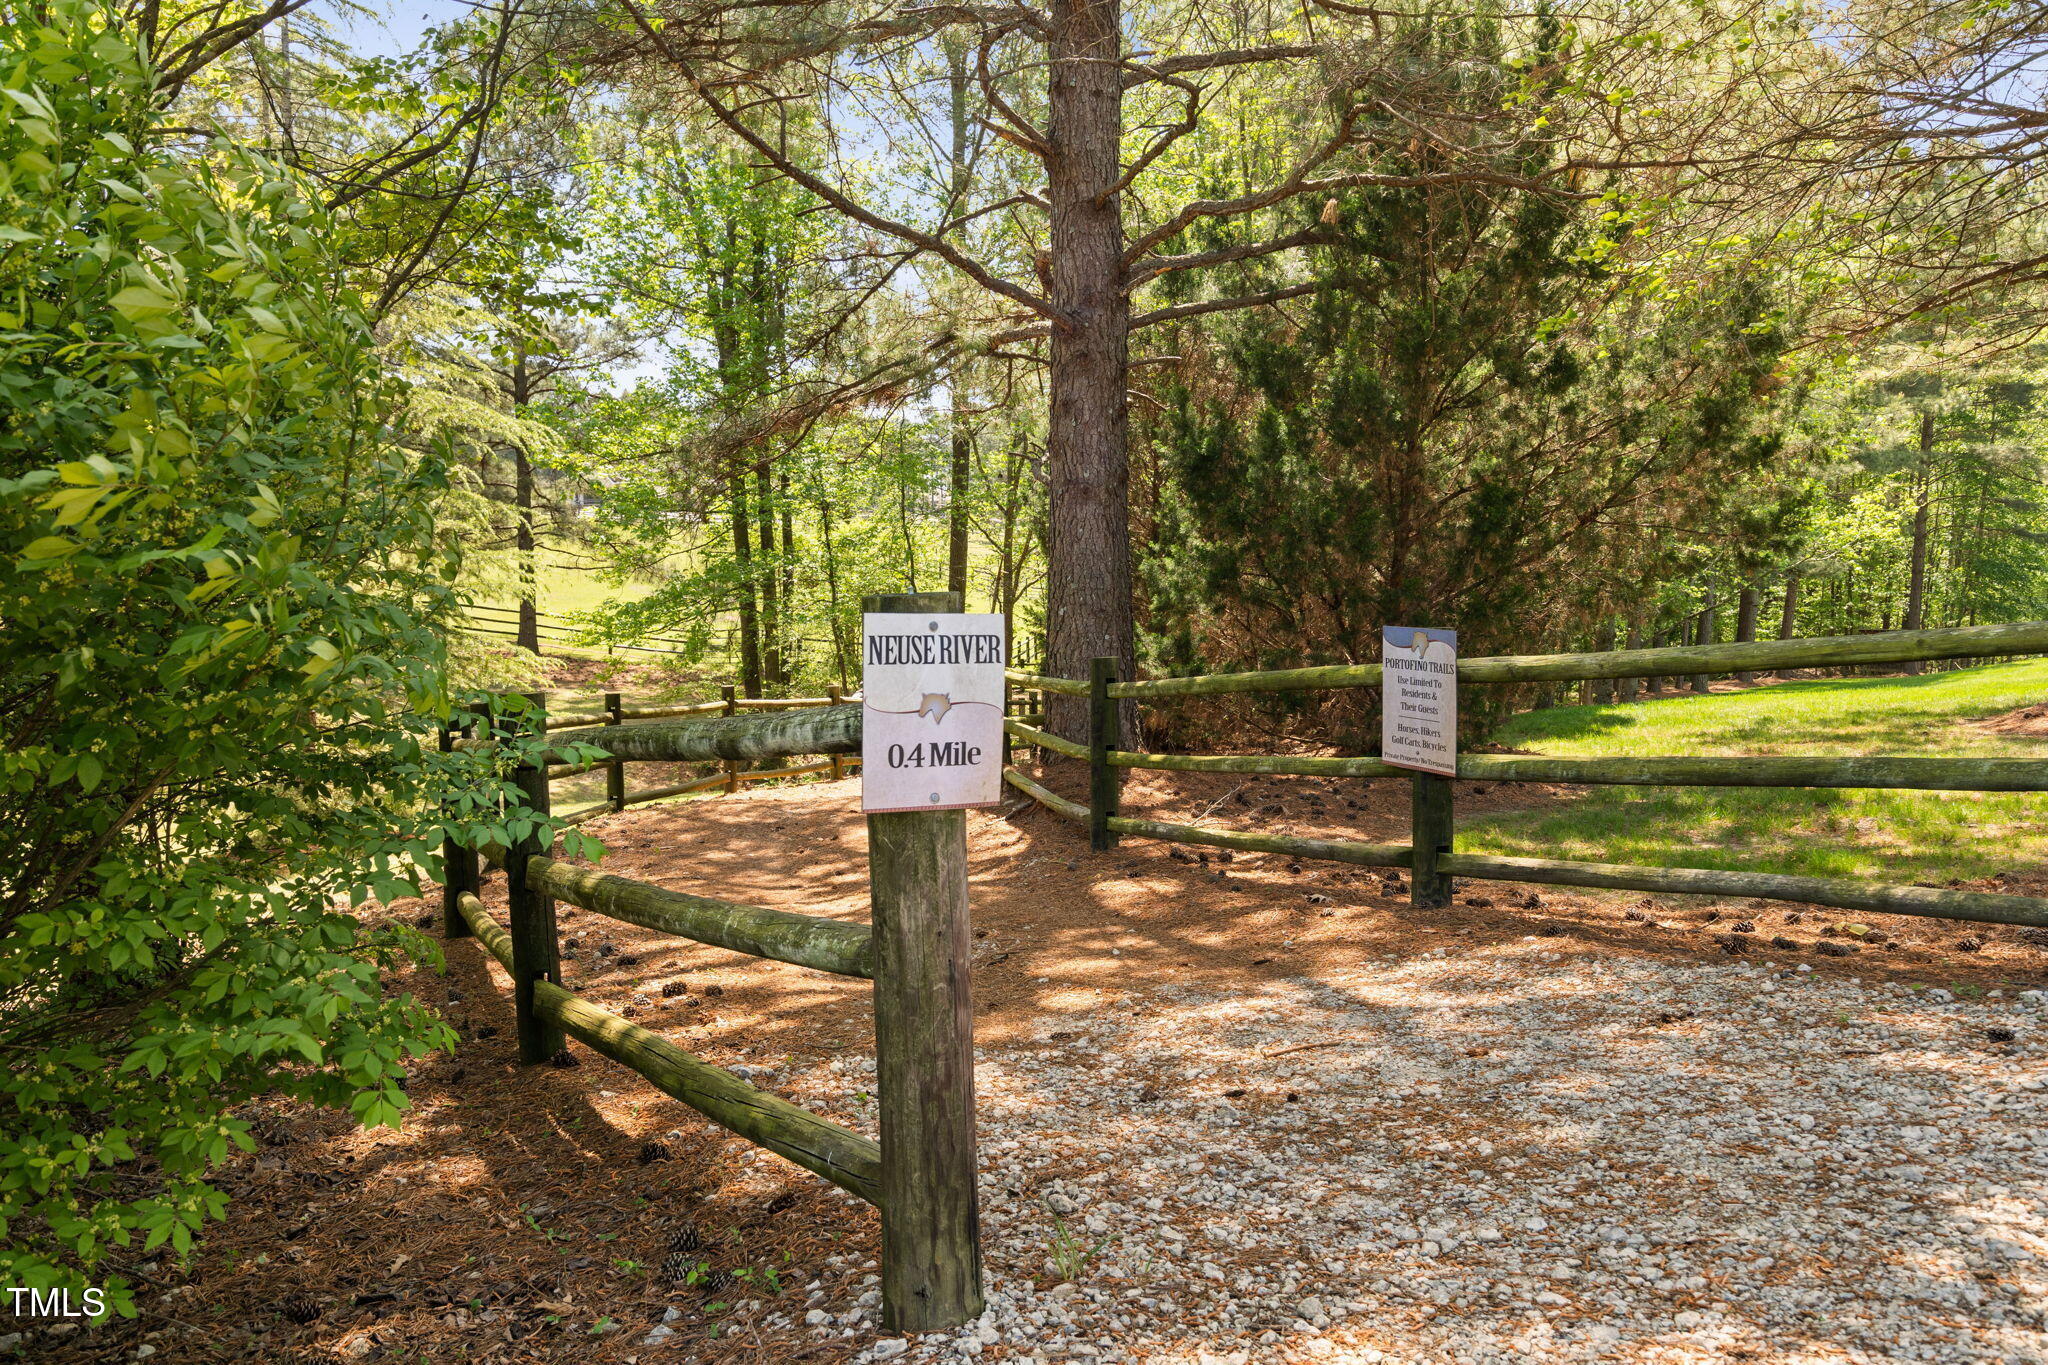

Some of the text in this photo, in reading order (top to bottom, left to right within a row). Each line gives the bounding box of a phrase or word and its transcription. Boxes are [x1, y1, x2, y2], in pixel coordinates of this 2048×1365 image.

[868, 635, 1002, 665] NEUSE RIVER
[1385, 658, 1454, 674] PORTOFINO TRAILS
[1398, 676, 1442, 688] Use Limited To
[1402, 688, 1437, 700] Residents &
[1400, 702, 1438, 714] Their Guests
[1421, 727, 1440, 737] Hikers
[1392, 736, 1404, 744] Golf
[1422, 740, 1446, 752] Bicycles
[888, 742, 981, 768] 0.4 Mile
